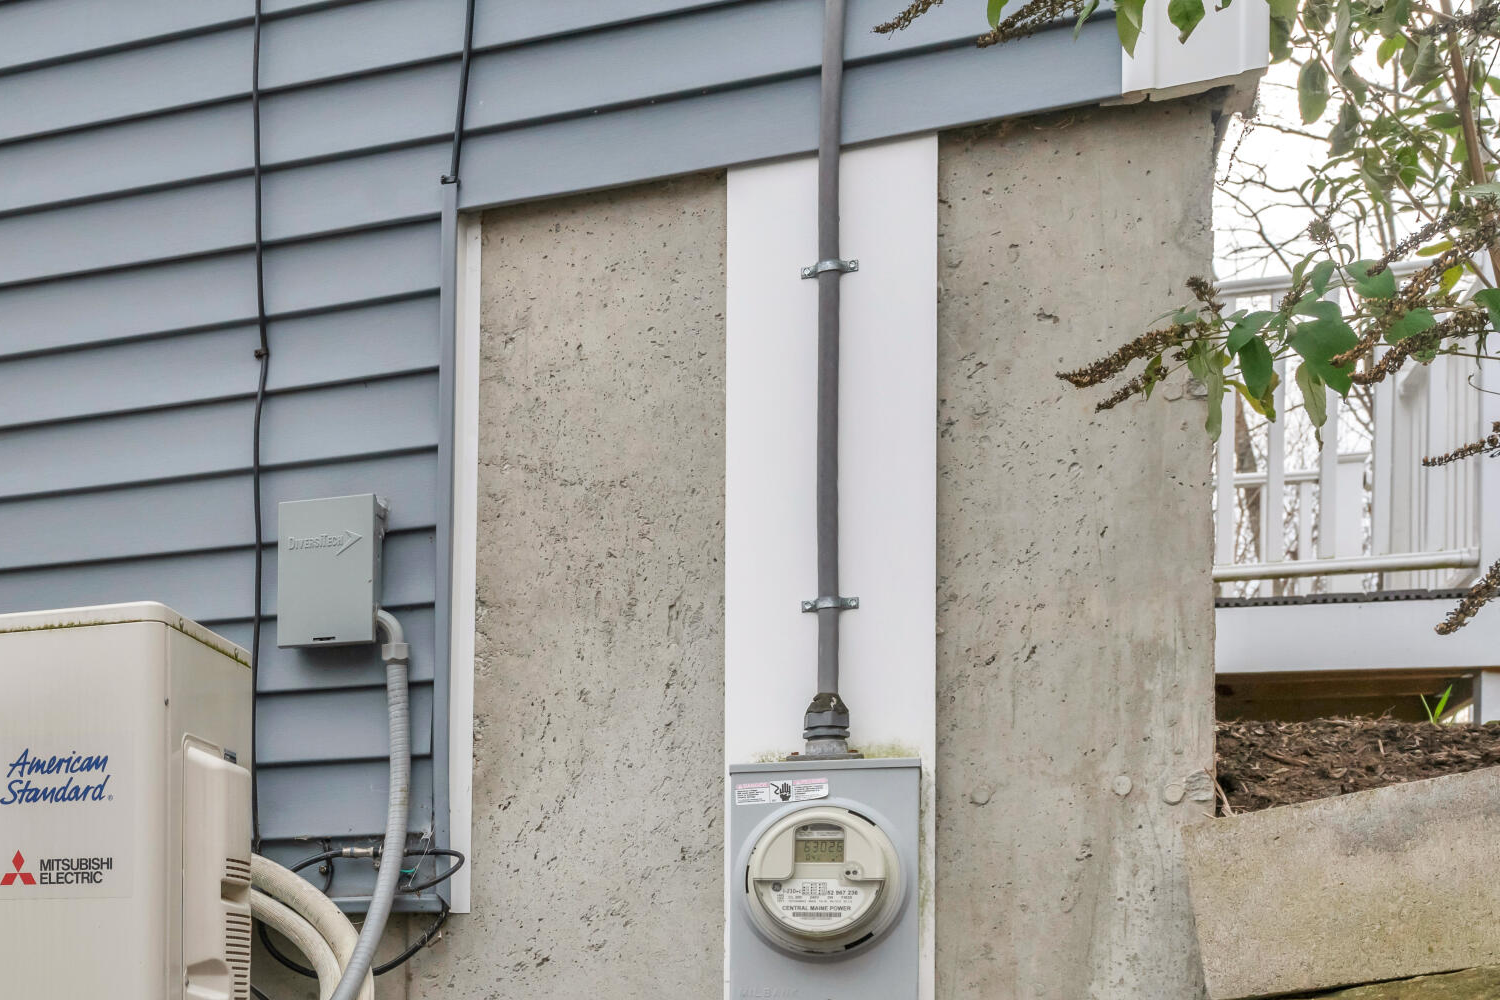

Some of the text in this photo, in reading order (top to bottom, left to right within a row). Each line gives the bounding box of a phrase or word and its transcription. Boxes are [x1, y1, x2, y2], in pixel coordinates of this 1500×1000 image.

[6, 748, 109, 778] American
[40, 858, 113, 872] MITSUBISHI
[40, 871, 103, 885] ELECTRIC
